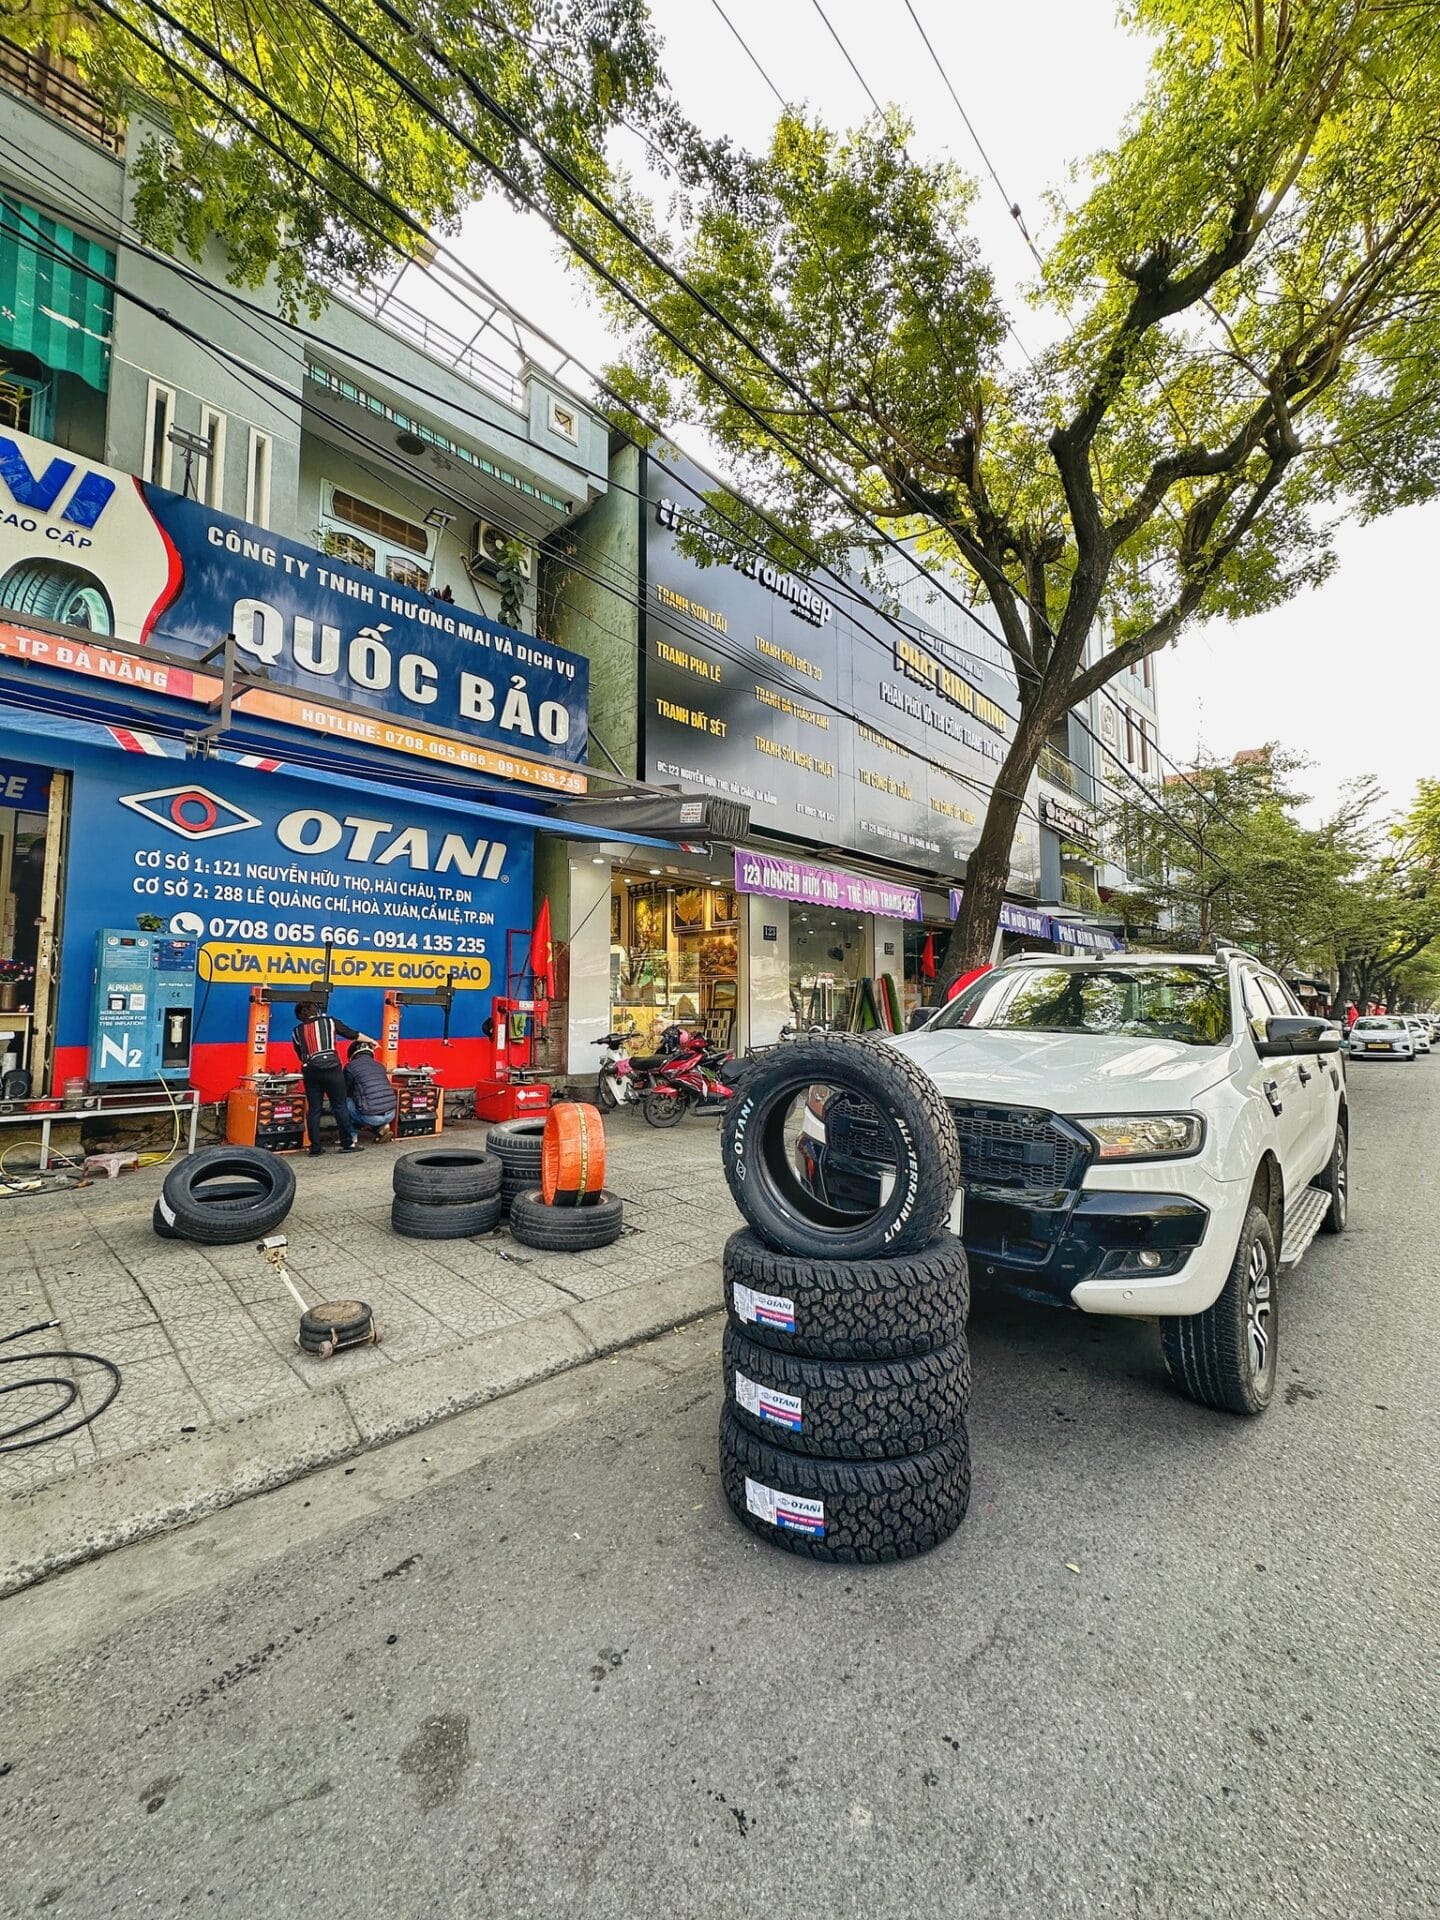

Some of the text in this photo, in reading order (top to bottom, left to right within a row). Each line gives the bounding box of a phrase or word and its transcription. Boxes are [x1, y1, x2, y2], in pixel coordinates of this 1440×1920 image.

[0, 508, 93, 549] AO CẤP
[207, 526, 276, 567] CÔNG
[283, 556, 310, 579] TY
[316, 567, 374, 605] TNHH
[379, 591, 455, 634] THƯƠNG
[494, 636, 513, 656] VÀ
[517, 645, 553, 670] DỊCH
[557, 660, 576, 681] VỤ
[656, 584, 688, 614] TRANH
[690, 602, 708, 622] SƠN
[15, 636, 168, 688] TP ĐÀ NẴNG
[656, 640, 721, 683] TRANH PHA LÊ
[754, 635, 780, 660] TRANH
[232, 598, 570, 745] QUỐC BẢO
[896, 638, 939, 690] PHÁT
[976, 689, 1008, 732] MINH
[755, 685, 780, 709] TRANH
[816, 713, 830, 730] ANH
[881, 681, 903, 709] PHÂN
[656, 698, 727, 738] TRANH ĐẤT SÉT
[301, 708, 381, 741] HOTLINE:
[385, 730, 486, 766] 0708.065.666
[498, 758, 581, 790] 0914.135.235
[754, 735, 781, 758] TRANH
[668, 764, 680, 777] 123
[680, 767, 704, 784] NGUYỄN
[277, 809, 508, 880] OTANI
[133, 876, 159, 894] CƠ
[164, 877, 188, 897] SỞ
[193, 883, 209, 899] 2:
[214, 885, 243, 901] 288
[247, 886, 265, 904] LÊ
[268, 890, 322, 909] QUẢNG
[352, 898, 380, 914] HOÀ
[134, 850, 472, 903] CƠ SỞ 1: 121 NGUYỄN HỮU THỌ, HẢI CHÂU, TP.ĐN
[743, 864, 760, 885] 123
[763, 865, 799, 893] NGUYỄN
[802, 873, 820, 896] HỮU
[822, 880, 838, 903] THỌ
[209, 918, 268, 940] 0708
[274, 922, 315, 943] 065
[320, 926, 360, 946] 666
[373, 930, 418, 950] 0914
[423, 934, 453, 951] 135
[456, 937, 486, 954] 235
[1028, 916, 1041, 934] THỌ
[214, 949, 262, 973] CỬA
[268, 952, 326, 975] HÀNG
[331, 956, 367, 976] LỐP
[371, 961, 394, 977] XE
[398, 961, 446, 980] QUỐC
[450, 962, 482, 980] BẢO
[100, 1032, 143, 1069] N2
[734, 1097, 754, 1155] OTANI
[884, 1117, 919, 1243] ALL-TERRAIN A/T
[766, 1300, 792, 1310] OTANI
[772, 1396, 799, 1409] OTANI
[791, 1501, 821, 1513] OTANI
